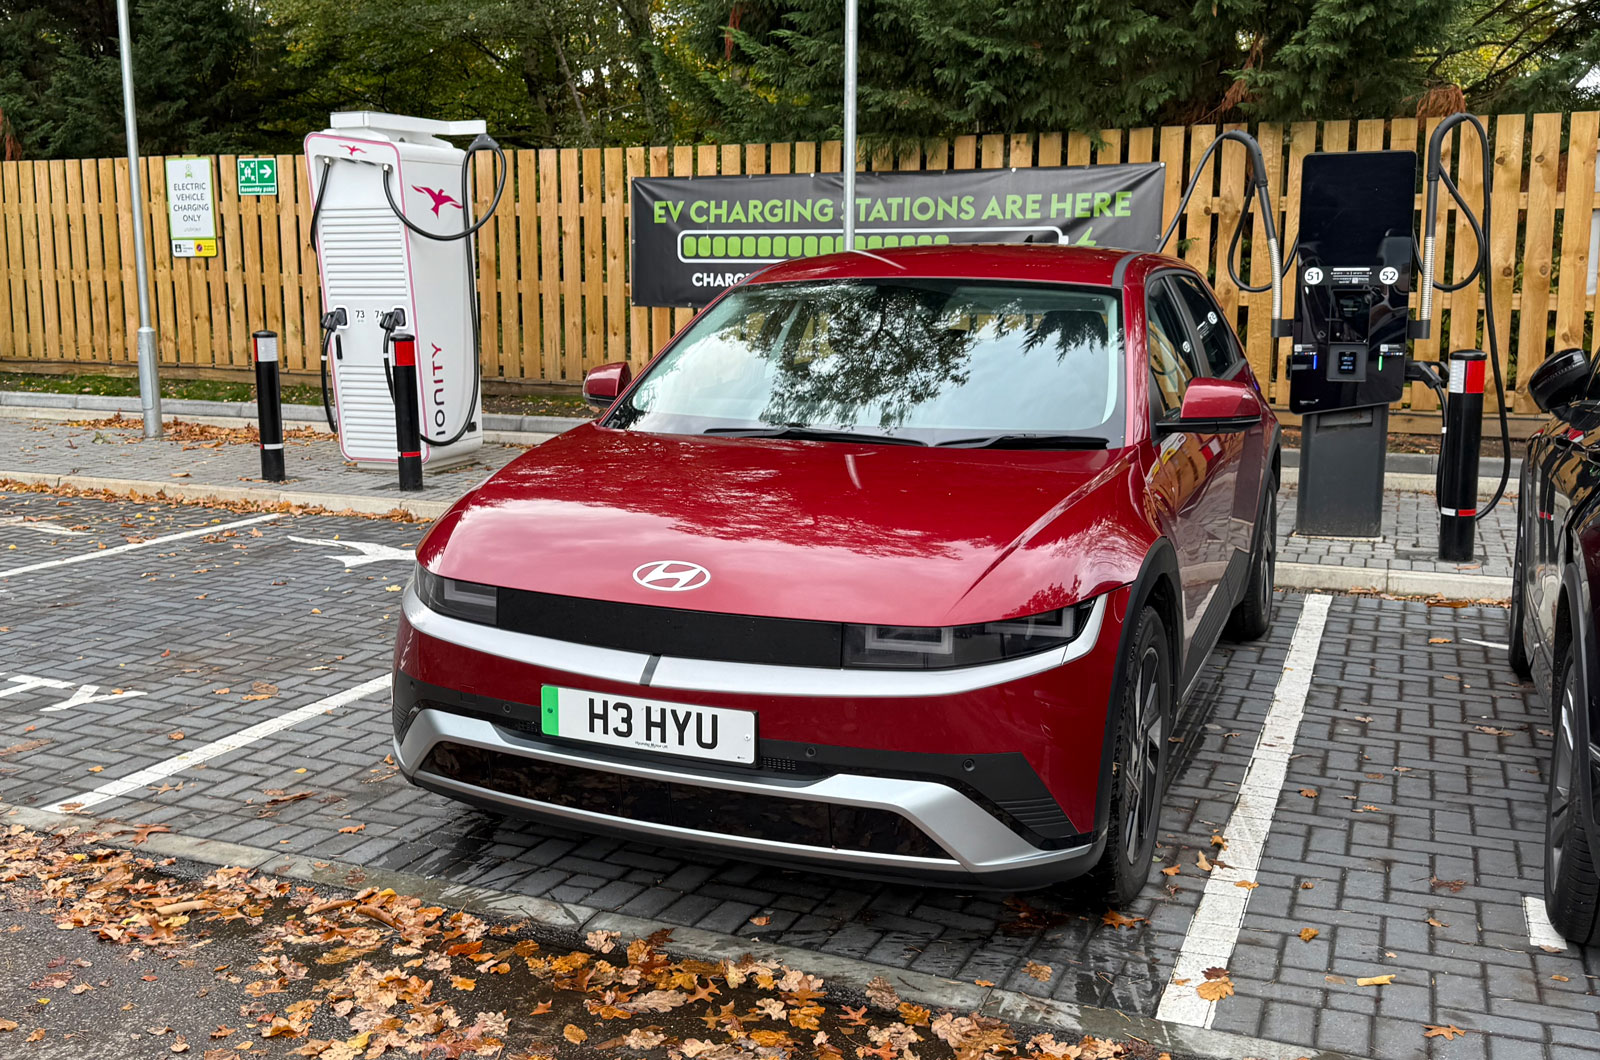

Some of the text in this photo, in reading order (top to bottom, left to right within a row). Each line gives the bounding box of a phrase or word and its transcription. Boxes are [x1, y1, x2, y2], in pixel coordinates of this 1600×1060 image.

[174, 182, 206, 191] ELECTRIC
[176, 193, 205, 201] VEHICLE
[173, 203, 209, 211] CHARGING
[653, 191, 1132, 224] EV CHARGING TATIONS ARE HERE
[182, 214, 201, 222] ONLY
[692, 272, 750, 287] CHARG
[1307, 271, 1320, 281] 51
[1382, 270, 1396, 281] 52
[355, 310, 365, 318] 73
[431, 342, 446, 436] IONITY
[588, 698, 718, 750] H3 HYU
